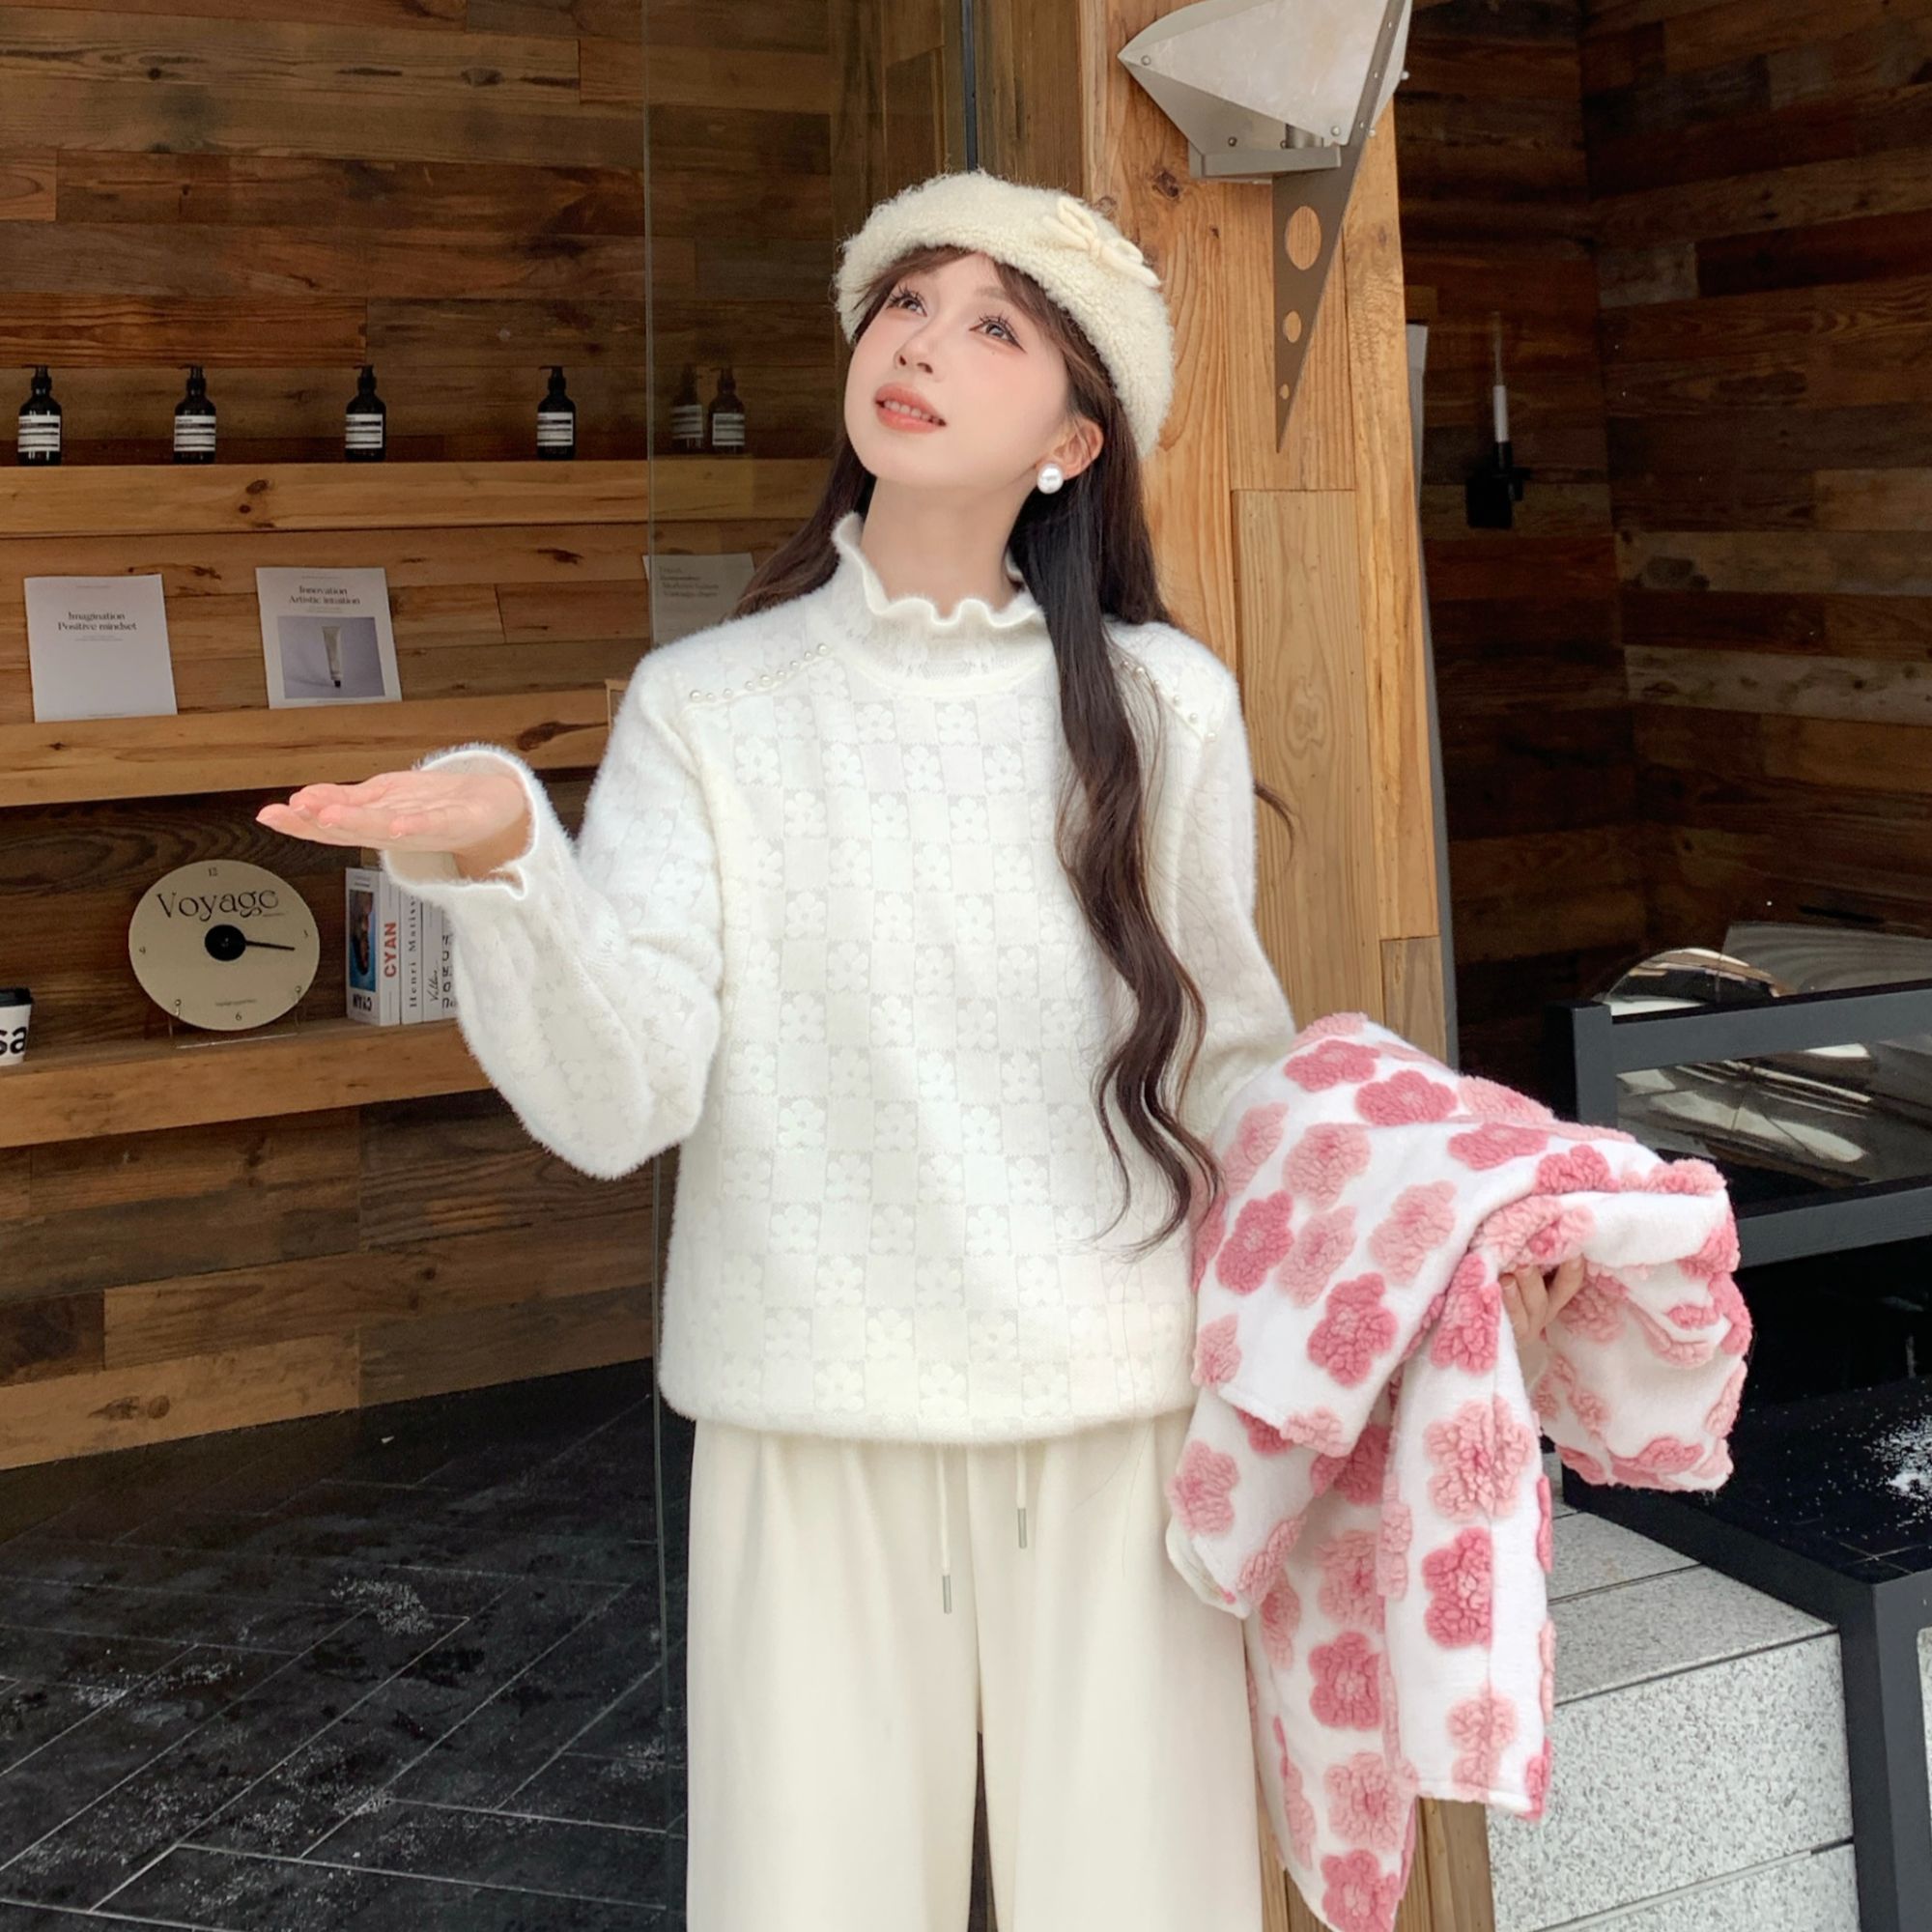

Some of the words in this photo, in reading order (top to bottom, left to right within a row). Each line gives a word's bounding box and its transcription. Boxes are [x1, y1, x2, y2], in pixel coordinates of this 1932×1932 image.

[298, 584, 348, 595] Innovation
[68, 611, 126, 621] Imagination
[58, 621, 98, 631] Positive
[99, 621, 137, 631] mindset
[384, 922, 397, 978] CYAN
[409, 962, 417, 1008] Henri
[235, 1012, 242, 1021] 6
